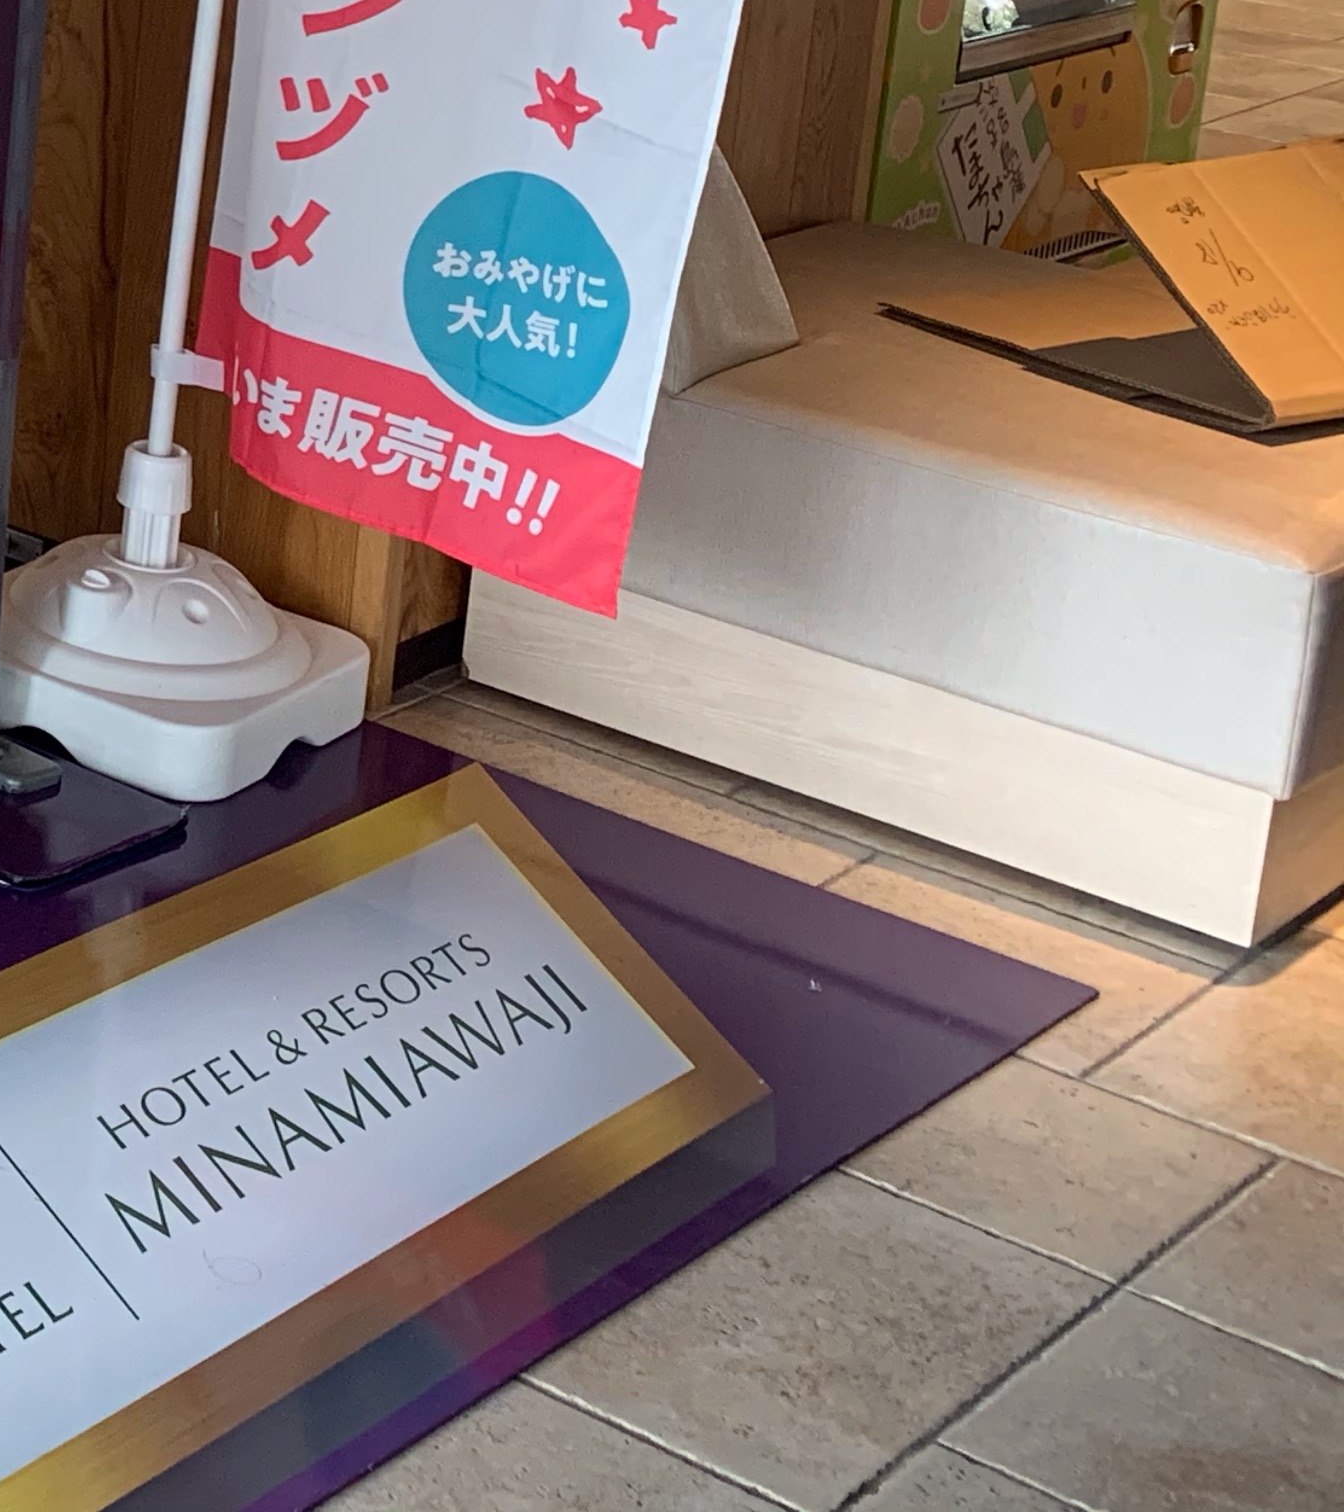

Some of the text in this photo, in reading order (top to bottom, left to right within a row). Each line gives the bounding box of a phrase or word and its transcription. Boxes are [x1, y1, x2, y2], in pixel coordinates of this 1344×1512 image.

[433, 242, 608, 310] おみやげに
[97, 933, 492, 1150] HOTEL & RESORTS
[105, 964, 588, 1254] MINAMIAWAJI
